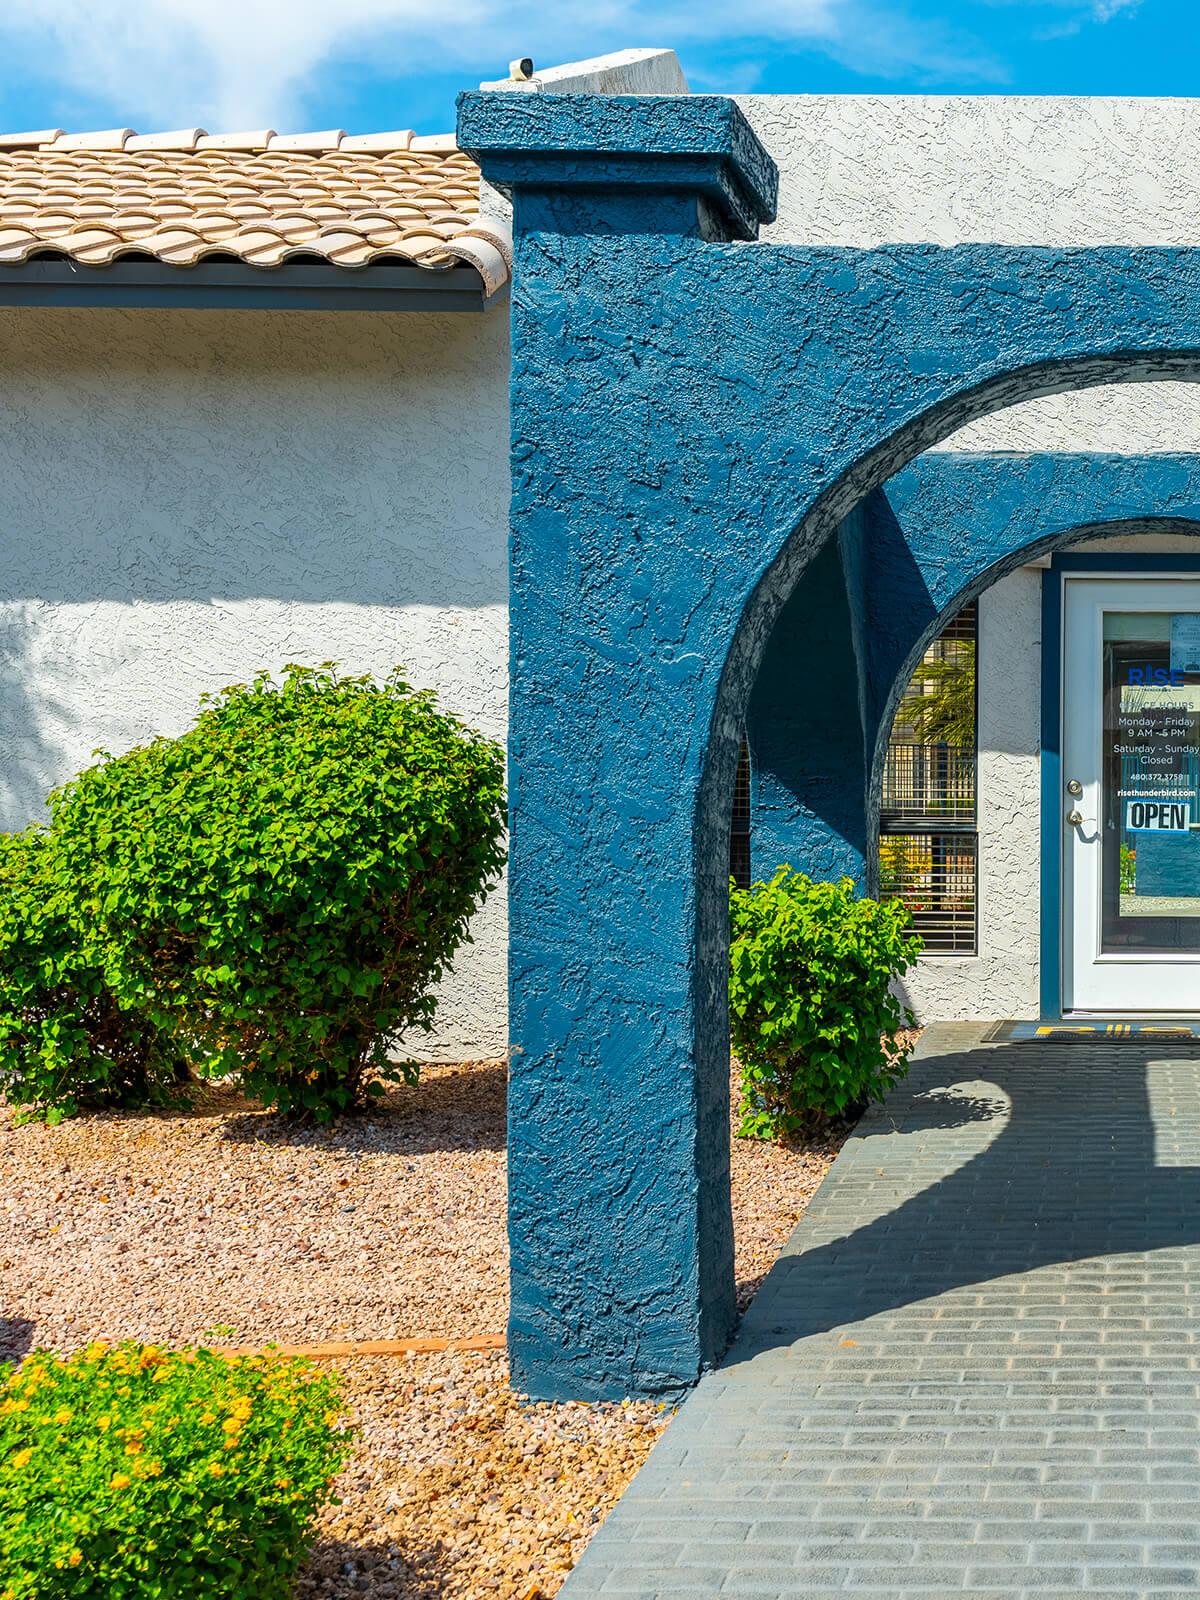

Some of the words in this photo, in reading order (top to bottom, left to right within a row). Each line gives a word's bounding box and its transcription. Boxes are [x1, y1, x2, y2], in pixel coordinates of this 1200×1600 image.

[1128, 664, 1185, 687] RISE
[1159, 702, 1194, 710] HOURS
[1118, 718, 1156, 727] Monday
[1165, 717, 1195, 727] Friday
[1128, 729, 1134, 737] 9
[1137, 729, 1153, 737] AM
[1162, 729, 1168, 737] 5
[1170, 729, 1186, 737] PM
[1113, 744, 1156, 754] Saturday
[1165, 744, 1200, 754] Sunday
[1140, 755, 1173, 764] Closed
[1117, 789, 1196, 797] risethunderbird.com
[1131, 802, 1185, 830] OPEN
